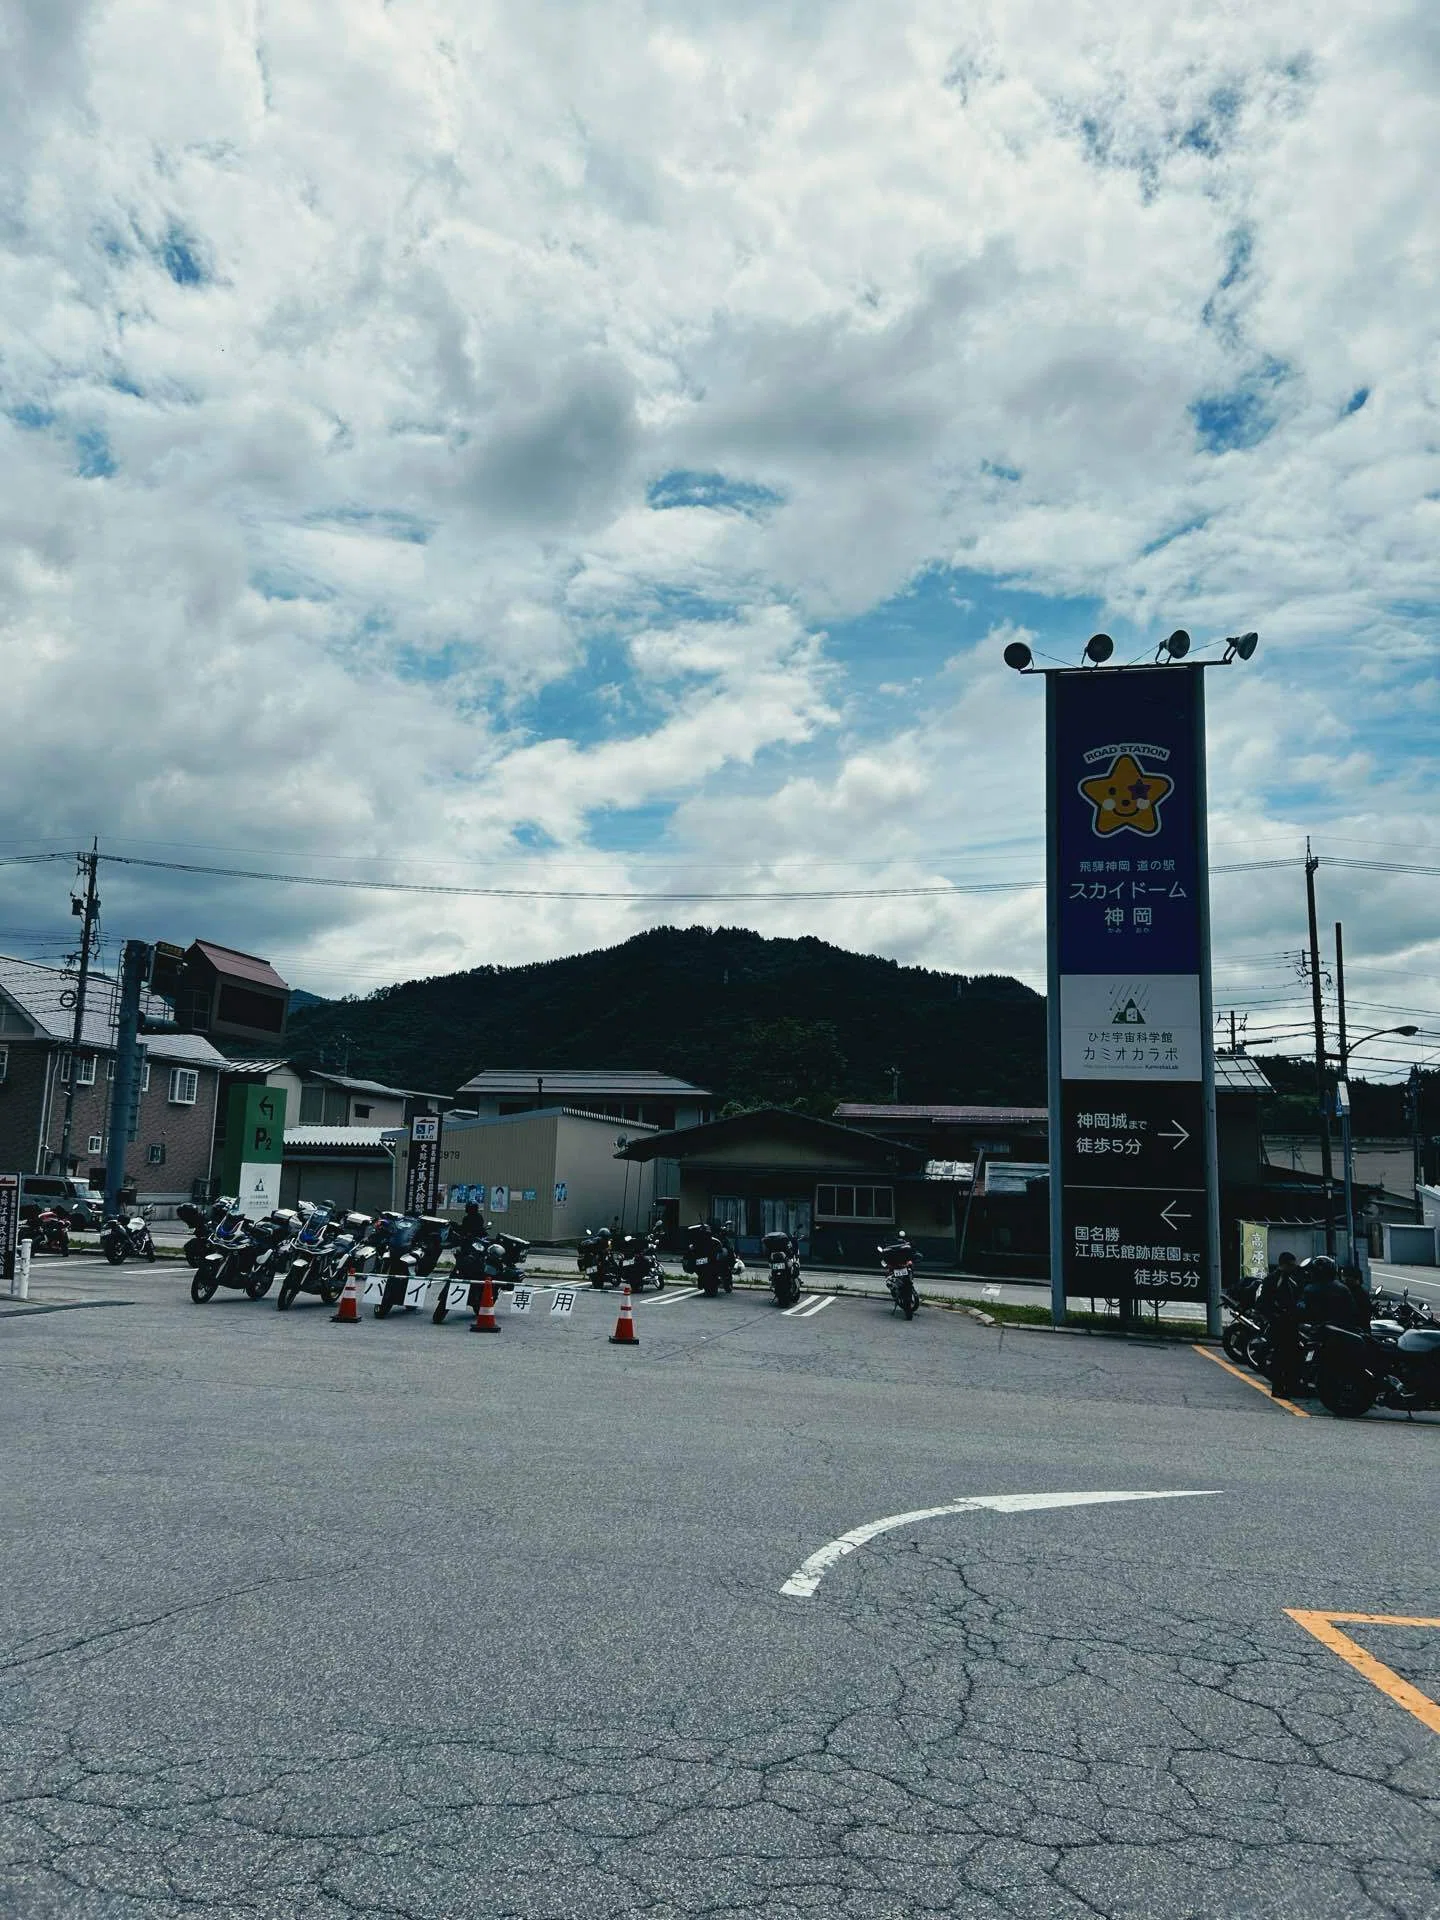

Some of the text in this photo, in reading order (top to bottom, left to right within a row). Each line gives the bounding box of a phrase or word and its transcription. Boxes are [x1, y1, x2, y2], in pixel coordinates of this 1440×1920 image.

[1086, 744, 1168, 761] ROAD STATION
[1136, 859, 1176, 872] 道の駅
[1068, 881, 1188, 900] スカイドーム
[1104, 907, 1152, 926] 神岡
[1088, 1031, 1173, 1043] ひだ宇宙科学館
[1077, 1112, 1148, 1130] 神岡城まで
[1076, 1137, 1142, 1155] 徒歩5分
[1074, 1226, 1120, 1242] 国名勝
[1134, 1268, 1201, 1288] 徒歩5分
